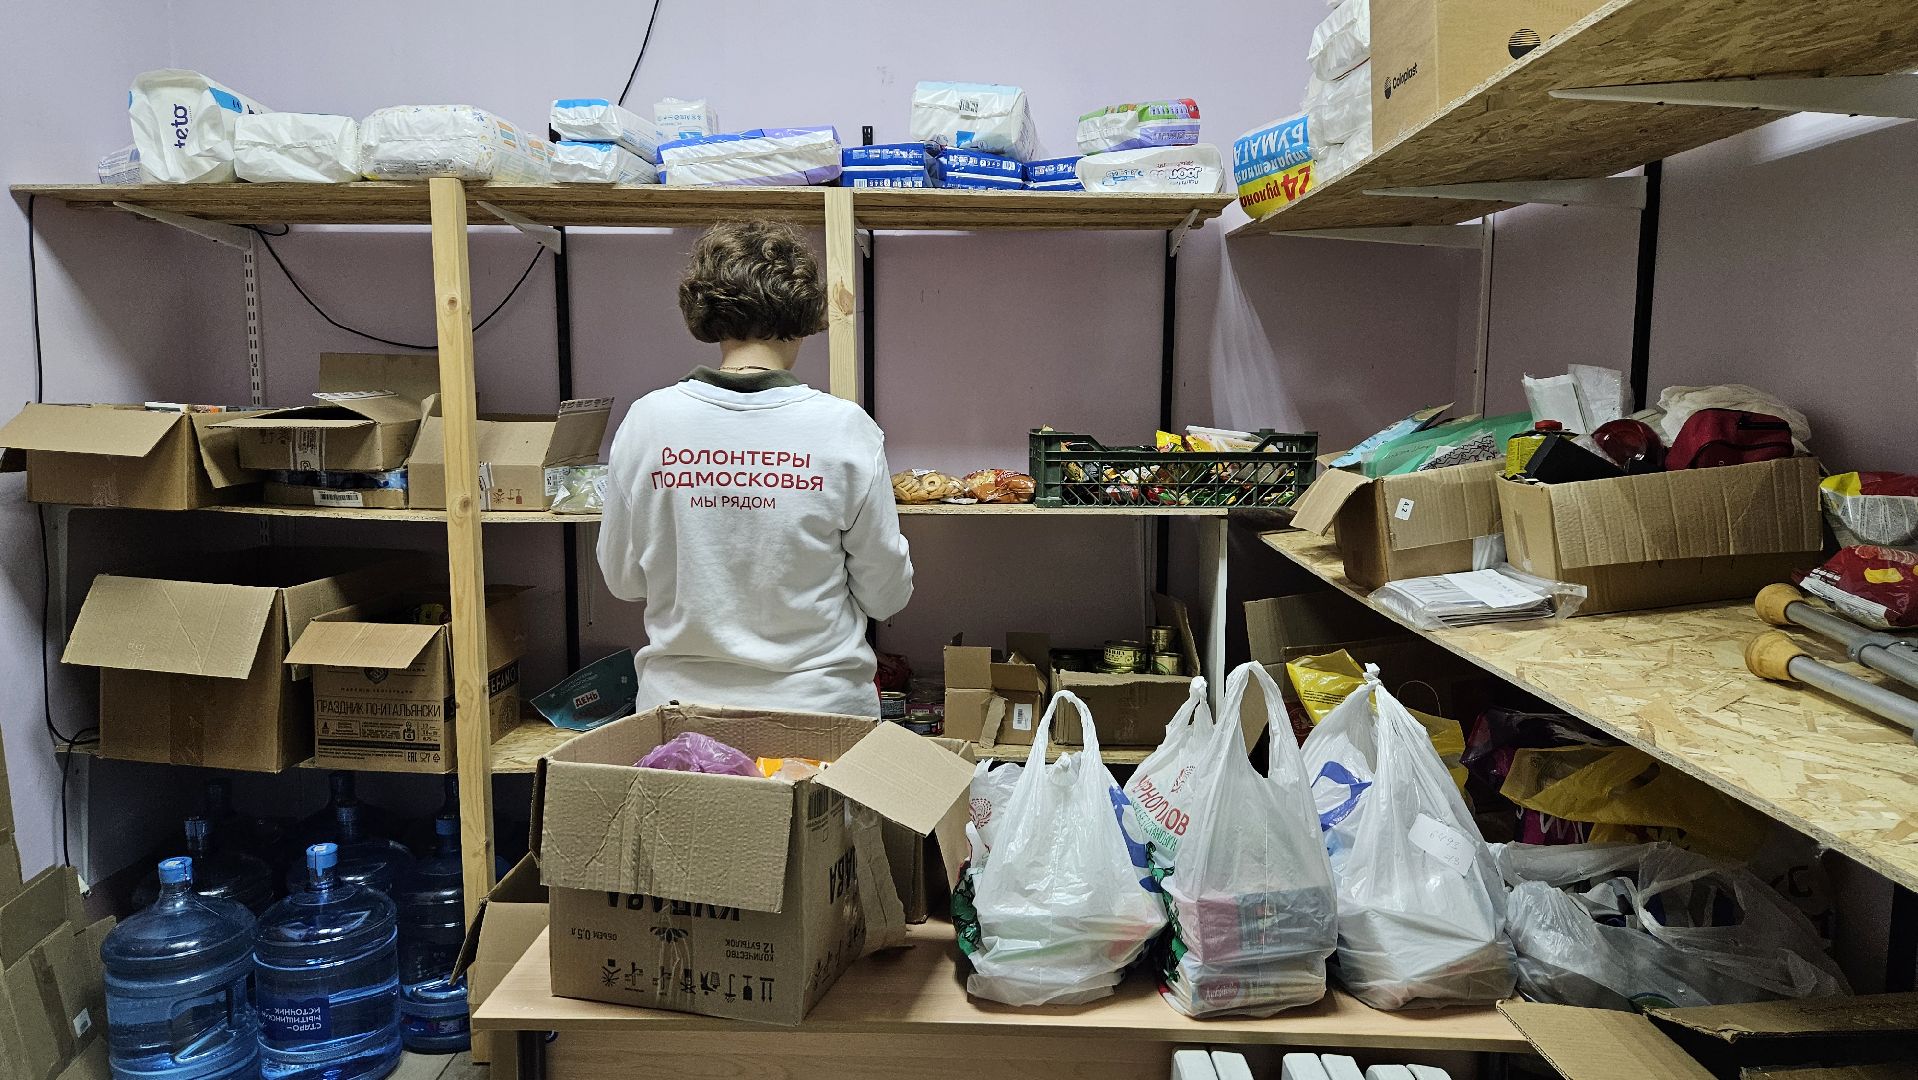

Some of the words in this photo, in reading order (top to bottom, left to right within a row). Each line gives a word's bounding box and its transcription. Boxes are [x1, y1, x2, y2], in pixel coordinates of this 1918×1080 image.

[1392, 62, 1418, 90] Coloplast
[1234, 121, 1305, 168] БУМАГА
[1281, 165, 1311, 202] 24
[662, 446, 811, 469] ВОЛОНТЕРЫ
[650, 470, 824, 492] ПОДМОСКОВЬЯ
[690, 495, 717, 508] МЫ
[722, 495, 776, 510] РЯДОМ
[489, 664, 515, 694] EFANO
[316, 699, 364, 715] ПРАЗДНИК
[366, 702, 441, 718] ПО-ИТАЛЬЯНСКИ
[575, 692, 599, 708] ДЕНЬ
[725, 938, 761, 951] БУТЫЛОК
[762, 942, 775, 954] 12
[725, 949, 775, 962] КОЛИЧЕСТВО
[274, 1006, 321, 1016] ИСТОЧНИК
